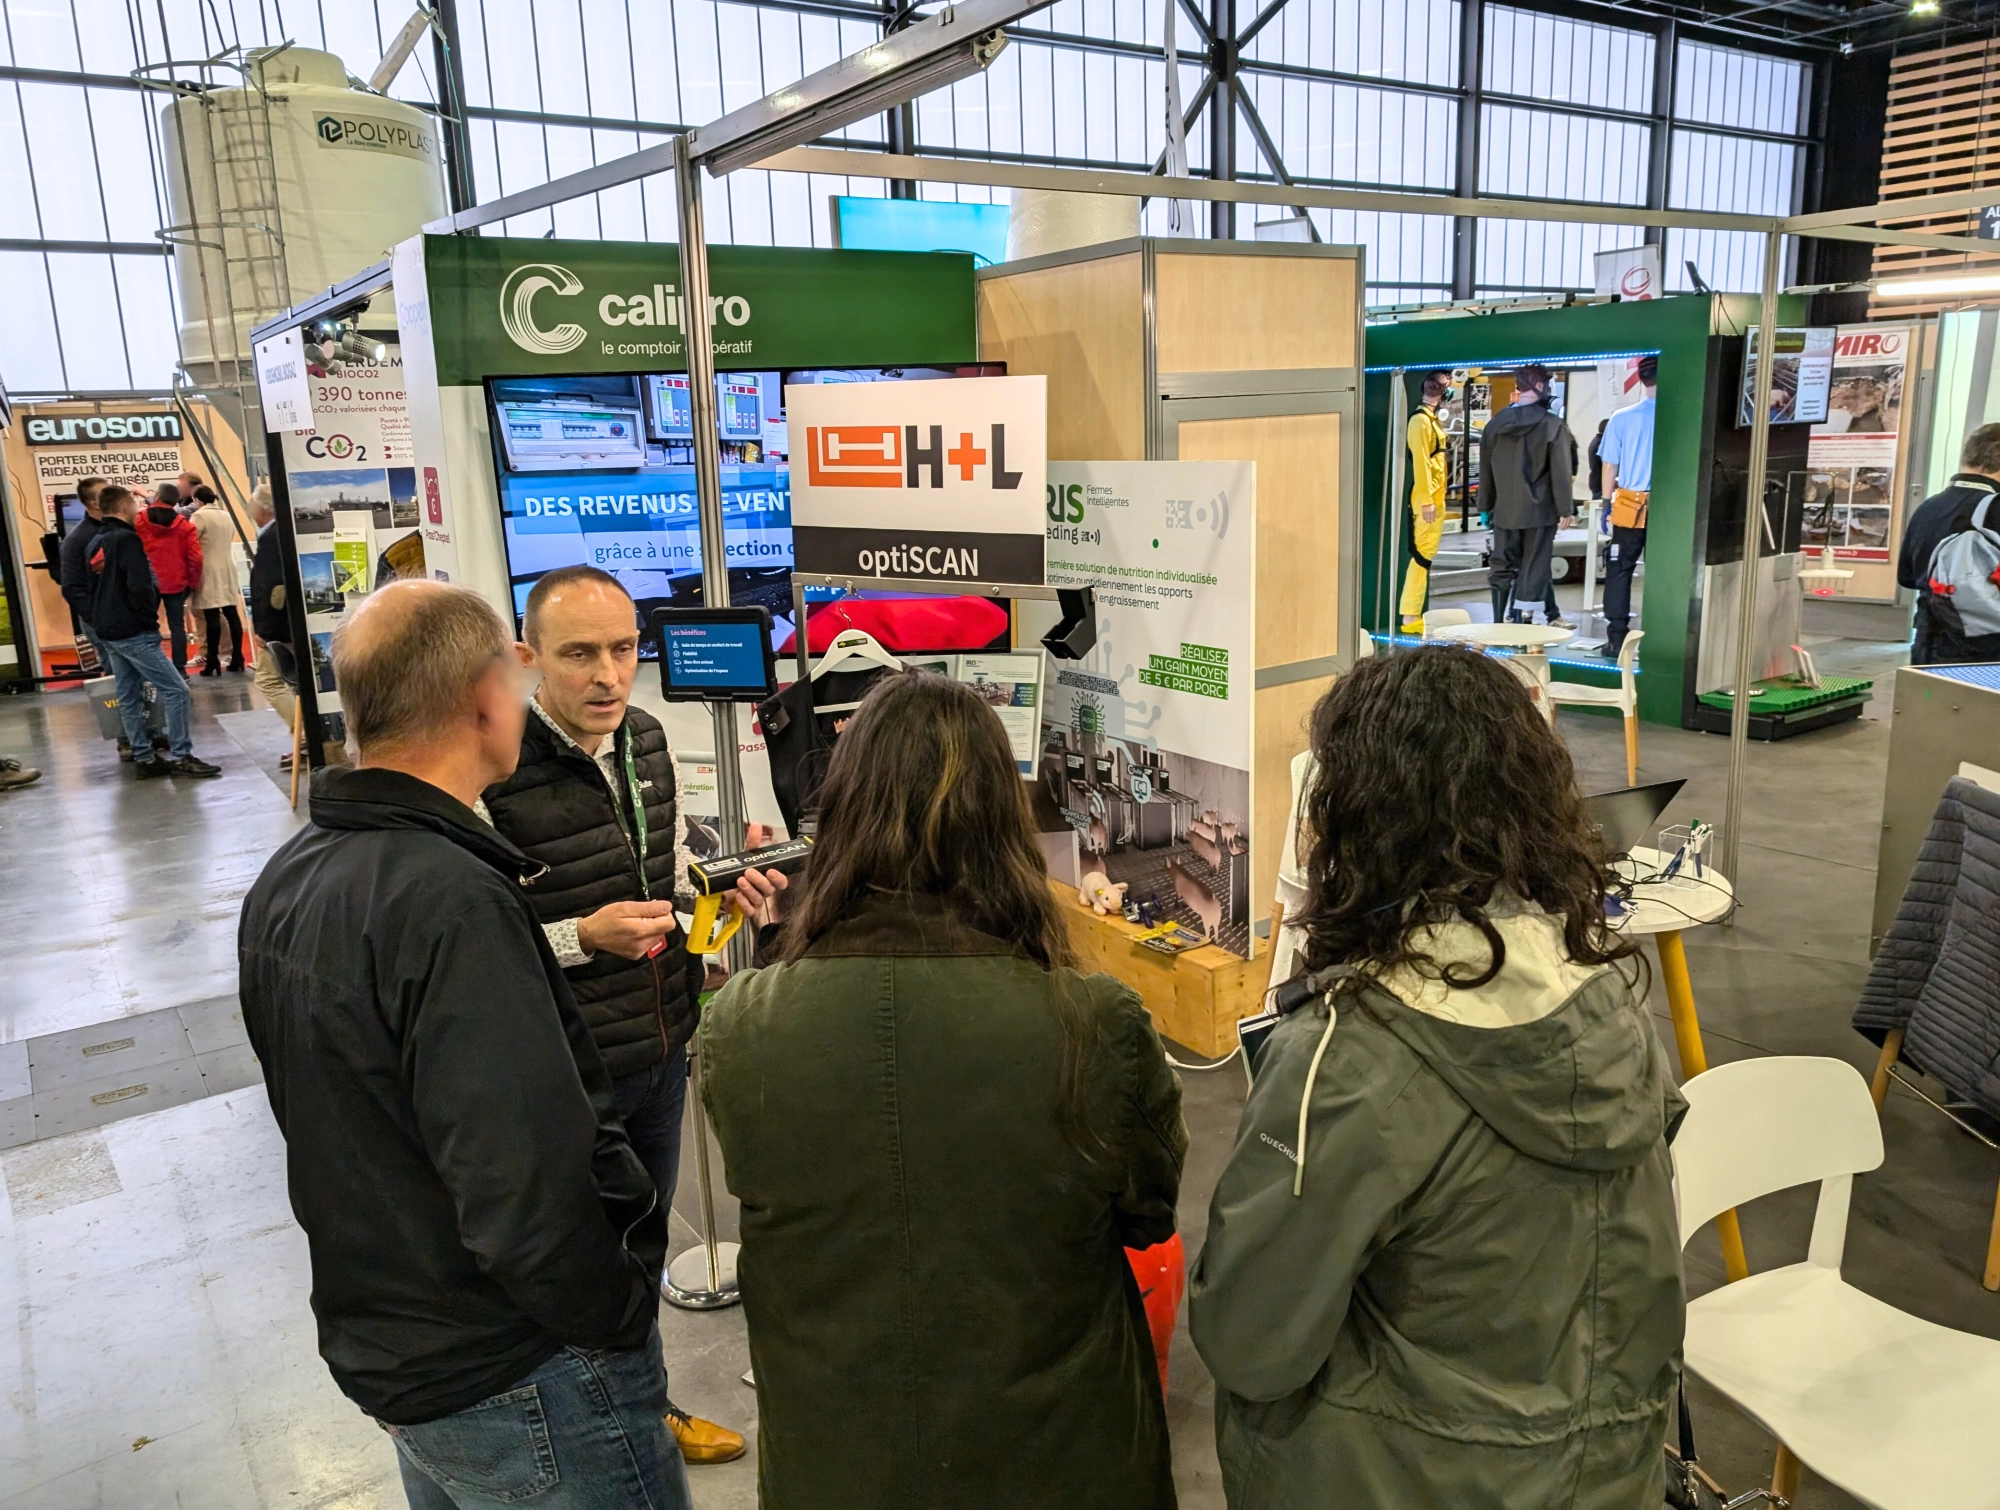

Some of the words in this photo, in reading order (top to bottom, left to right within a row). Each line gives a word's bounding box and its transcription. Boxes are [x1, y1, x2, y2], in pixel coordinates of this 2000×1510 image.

[343, 121, 433, 154] POLYPLAST
[601, 341, 614, 354] le
[618, 341, 681, 357] comptoir
[337, 370, 379, 378] BIOCO2
[318, 387, 352, 402] 390
[340, 405, 377, 413] valorisées
[379, 404, 406, 414] chaque
[28, 416, 180, 441] eurosom
[39, 455, 88, 466] PORTES
[92, 452, 178, 464] ENROULABLES
[42, 466, 98, 477] RIDEAUX
[103, 464, 119, 474] DE
[123, 462, 180, 474] FAÇADES
[1087, 485, 1113, 495] Fermes
[525, 497, 572, 516] DES
[579, 494, 692, 516] REVENUS
[1087, 496, 1130, 508] Intelligentes
[1047, 525, 1078, 545] eding
[595, 543, 642, 564] grâce
[647, 542, 657, 558] à
[662, 546, 694, 558] une
[858, 544, 978, 578] optiSCAN
[1047, 560, 1074, 570] remière
[1076, 562, 1106, 574] solution
[1107, 565, 1117, 575] de
[1119, 566, 1154, 579] nutrition
[1156, 569, 1218, 585] individualisée
[1145, 583, 1156, 594] les
[1158, 586, 1193, 598] apports
[1100, 594, 1159, 610] engraissement
[1181, 644, 1228, 664] RÉALISEZ
[1150, 656, 1163, 669] UN
[1165, 660, 1189, 674] GAIN
[1192, 664, 1228, 682] MOYEN
[1140, 671, 1151, 684] DE
[1155, 674, 1161, 685] 5
[1164, 676, 1170, 687] €
[1173, 678, 1193, 692] PAR
[1195, 682, 1224, 698] PORC
[738, 743, 766, 753] Pass
[744, 843, 807, 863] optiSCAN
[1260, 1132, 1298, 1163] QUECHUA
